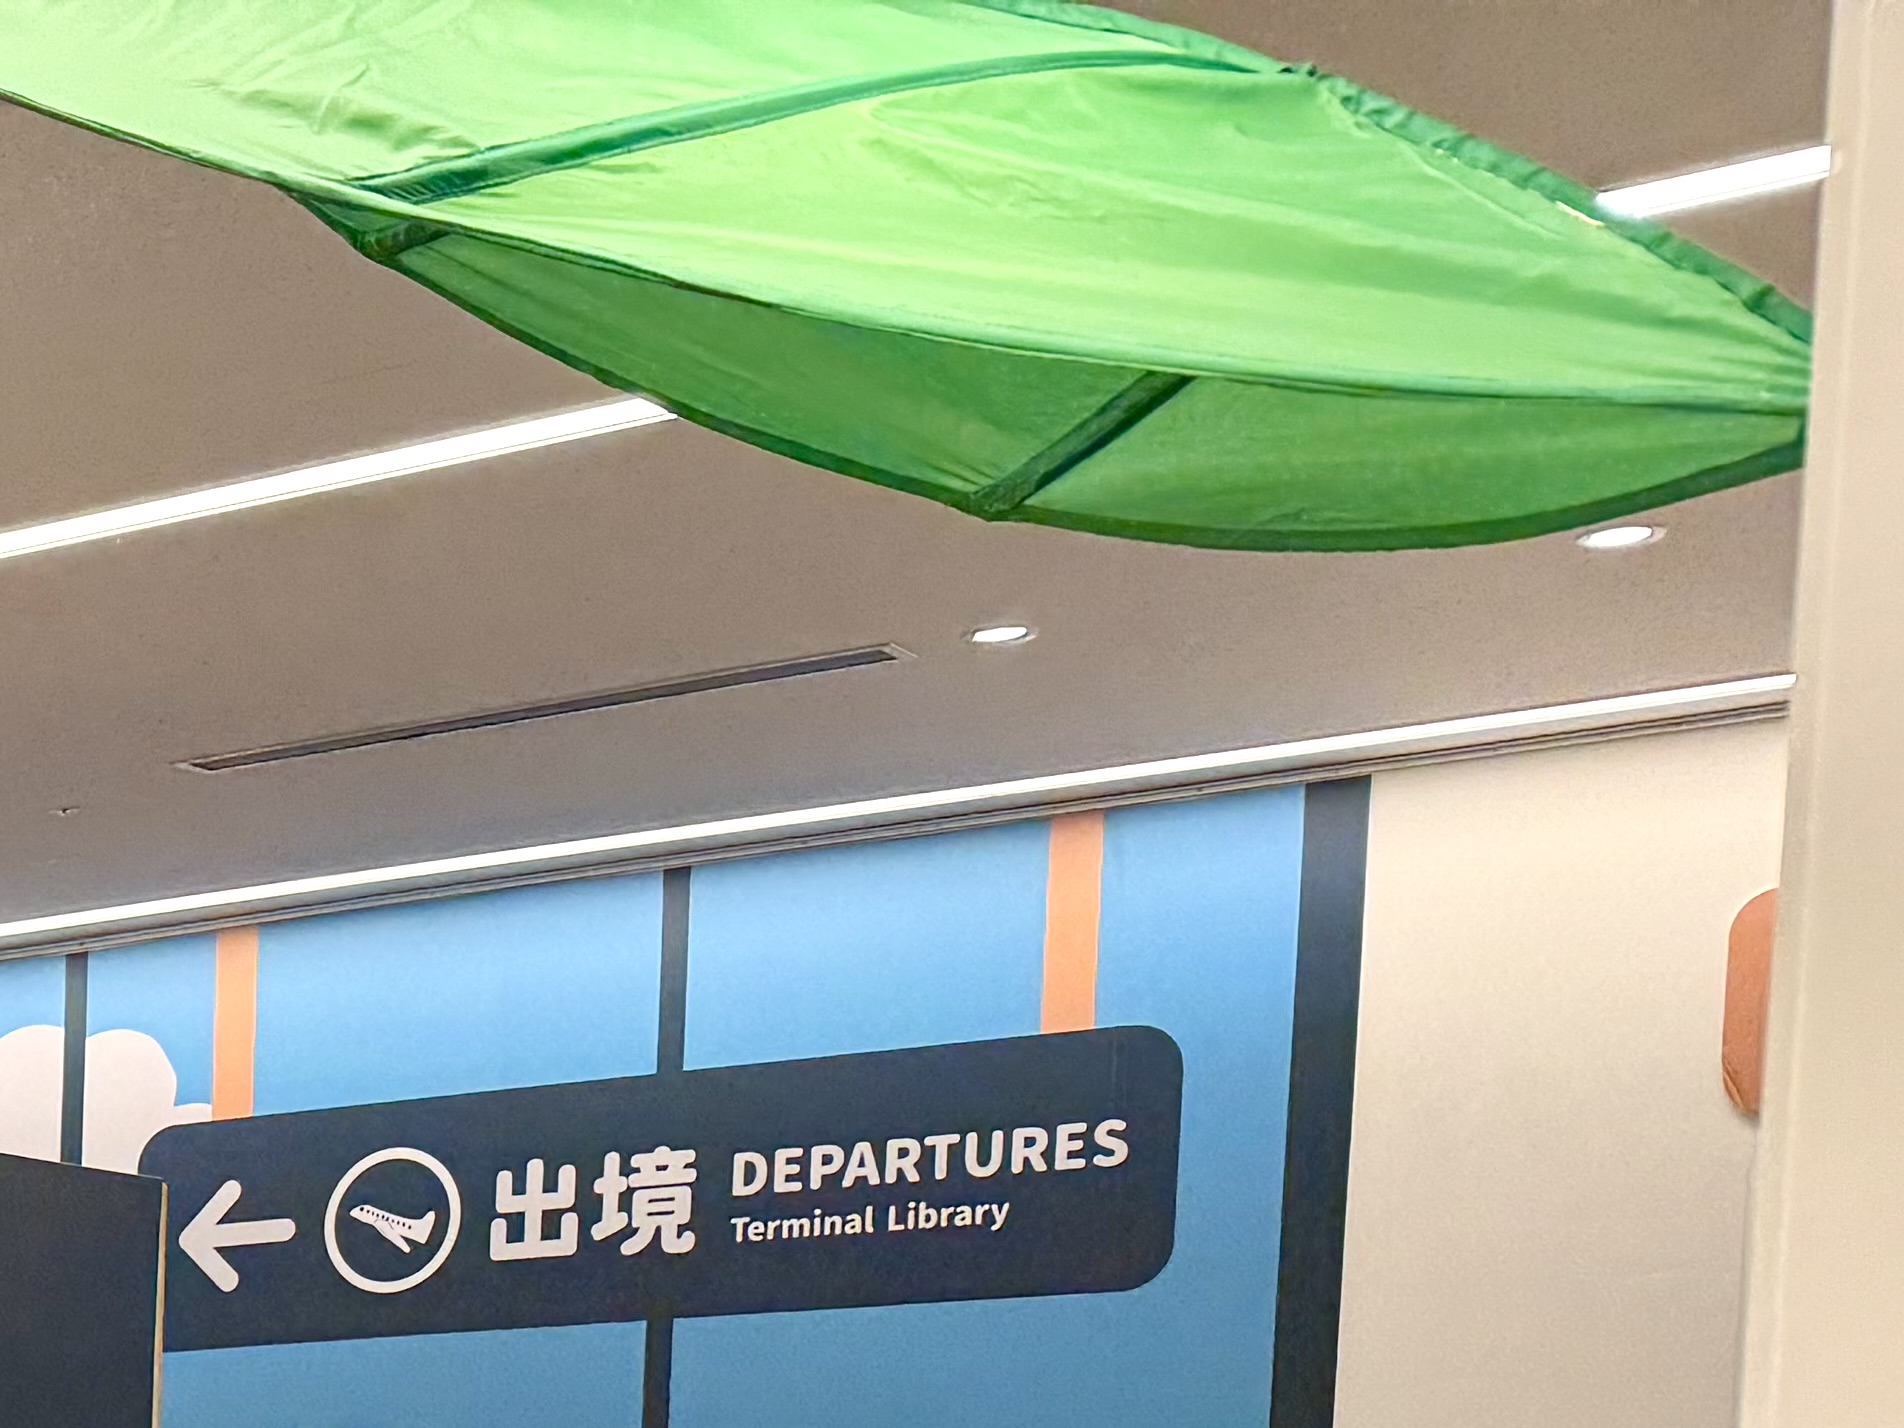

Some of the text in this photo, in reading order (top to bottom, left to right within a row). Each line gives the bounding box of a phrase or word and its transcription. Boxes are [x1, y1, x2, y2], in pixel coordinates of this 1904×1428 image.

[730, 1118, 1128, 1199] DEPARTURES
[490, 1146, 697, 1263] 出境
[730, 1197, 1011, 1245] Terminal Library
